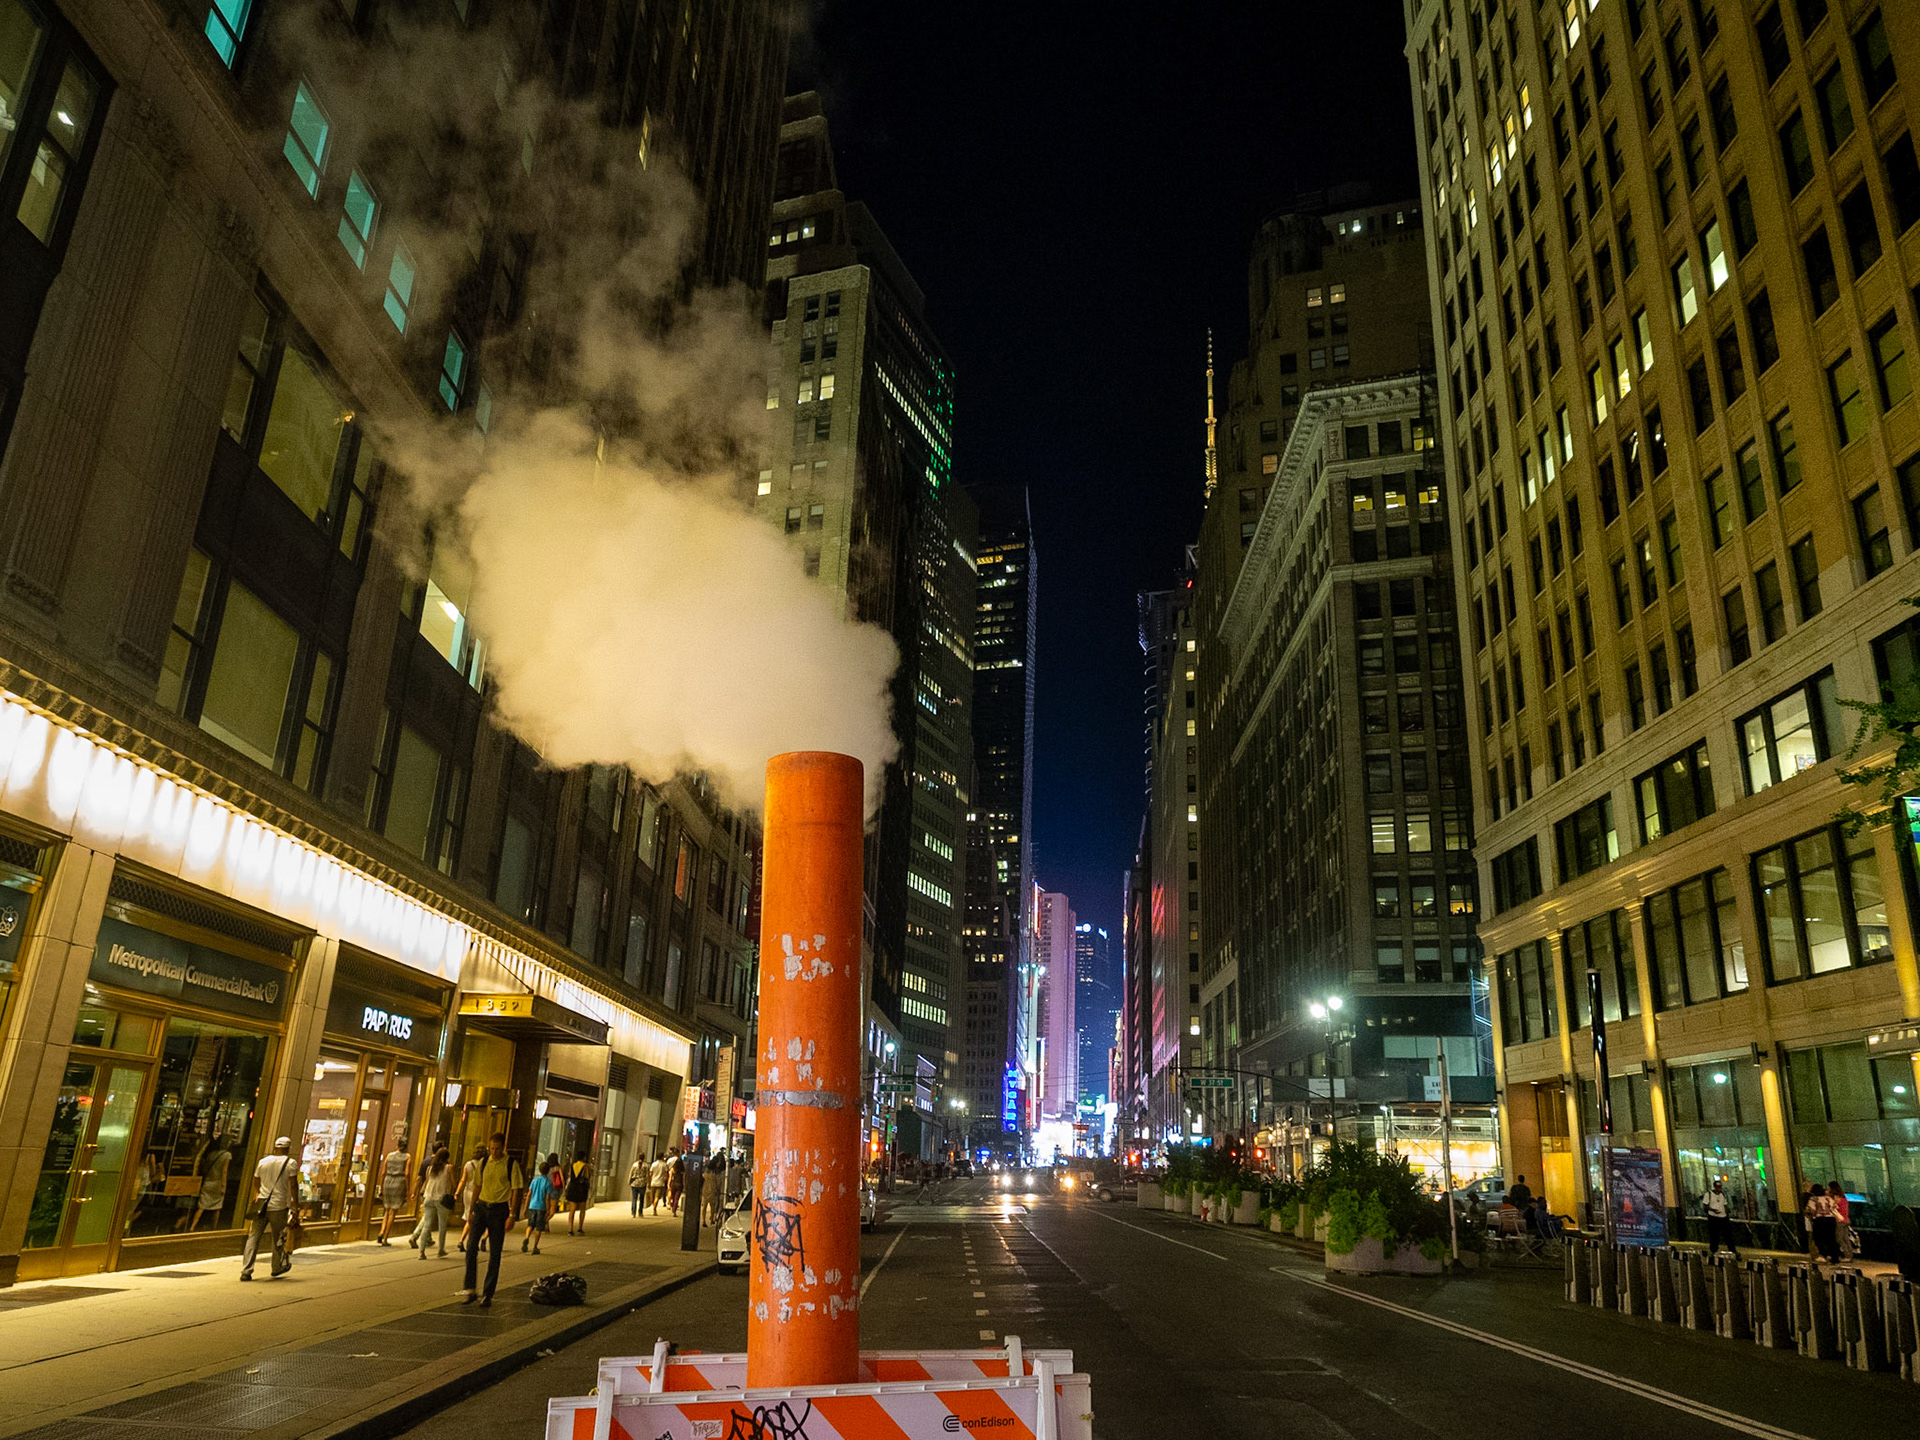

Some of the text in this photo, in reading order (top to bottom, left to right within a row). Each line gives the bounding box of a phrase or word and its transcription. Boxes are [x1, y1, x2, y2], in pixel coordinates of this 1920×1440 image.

[108, 943, 264, 1001] Metropolitan Commercial Bank
[361, 1006, 413, 1040] PAPYRUS
[690, 1088, 698, 1119] PIZZA
[693, 1161, 699, 1171] P
[961, 1417, 1015, 1428] conEdison
